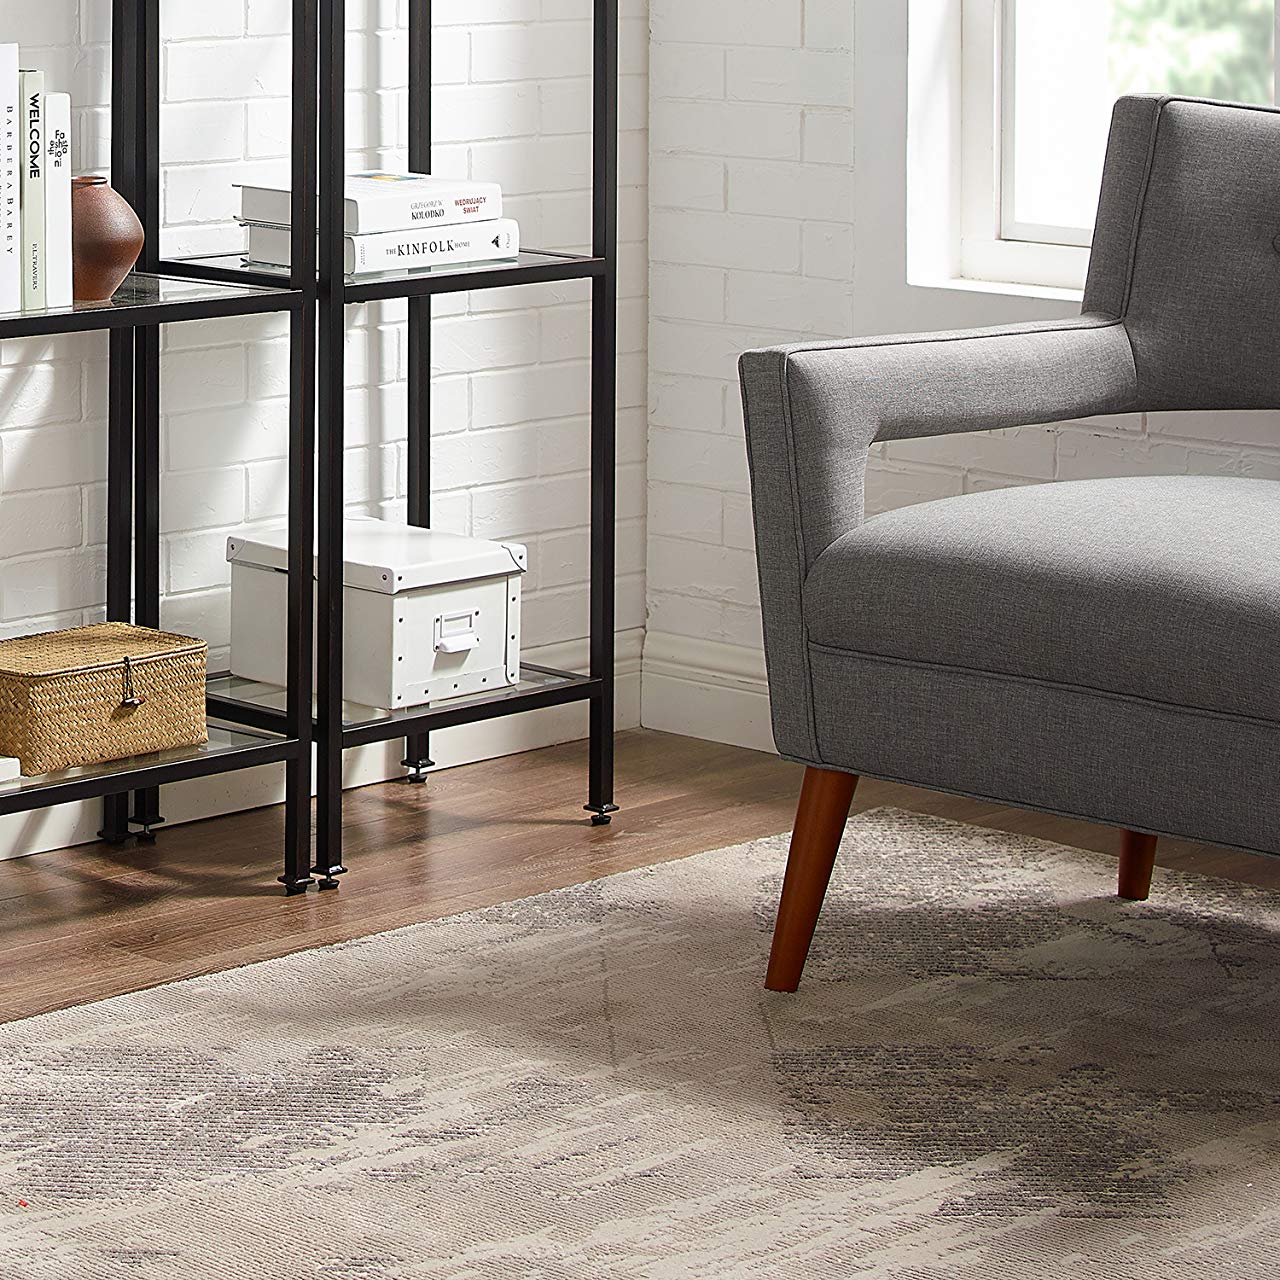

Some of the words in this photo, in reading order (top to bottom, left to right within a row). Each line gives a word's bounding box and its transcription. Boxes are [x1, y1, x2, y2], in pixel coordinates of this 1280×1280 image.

[29, 92, 40, 179] WELCOME
[386, 248, 397, 256] THE
[397, 239, 455, 257] KINFOLK
[454, 240, 471, 249] HOME
